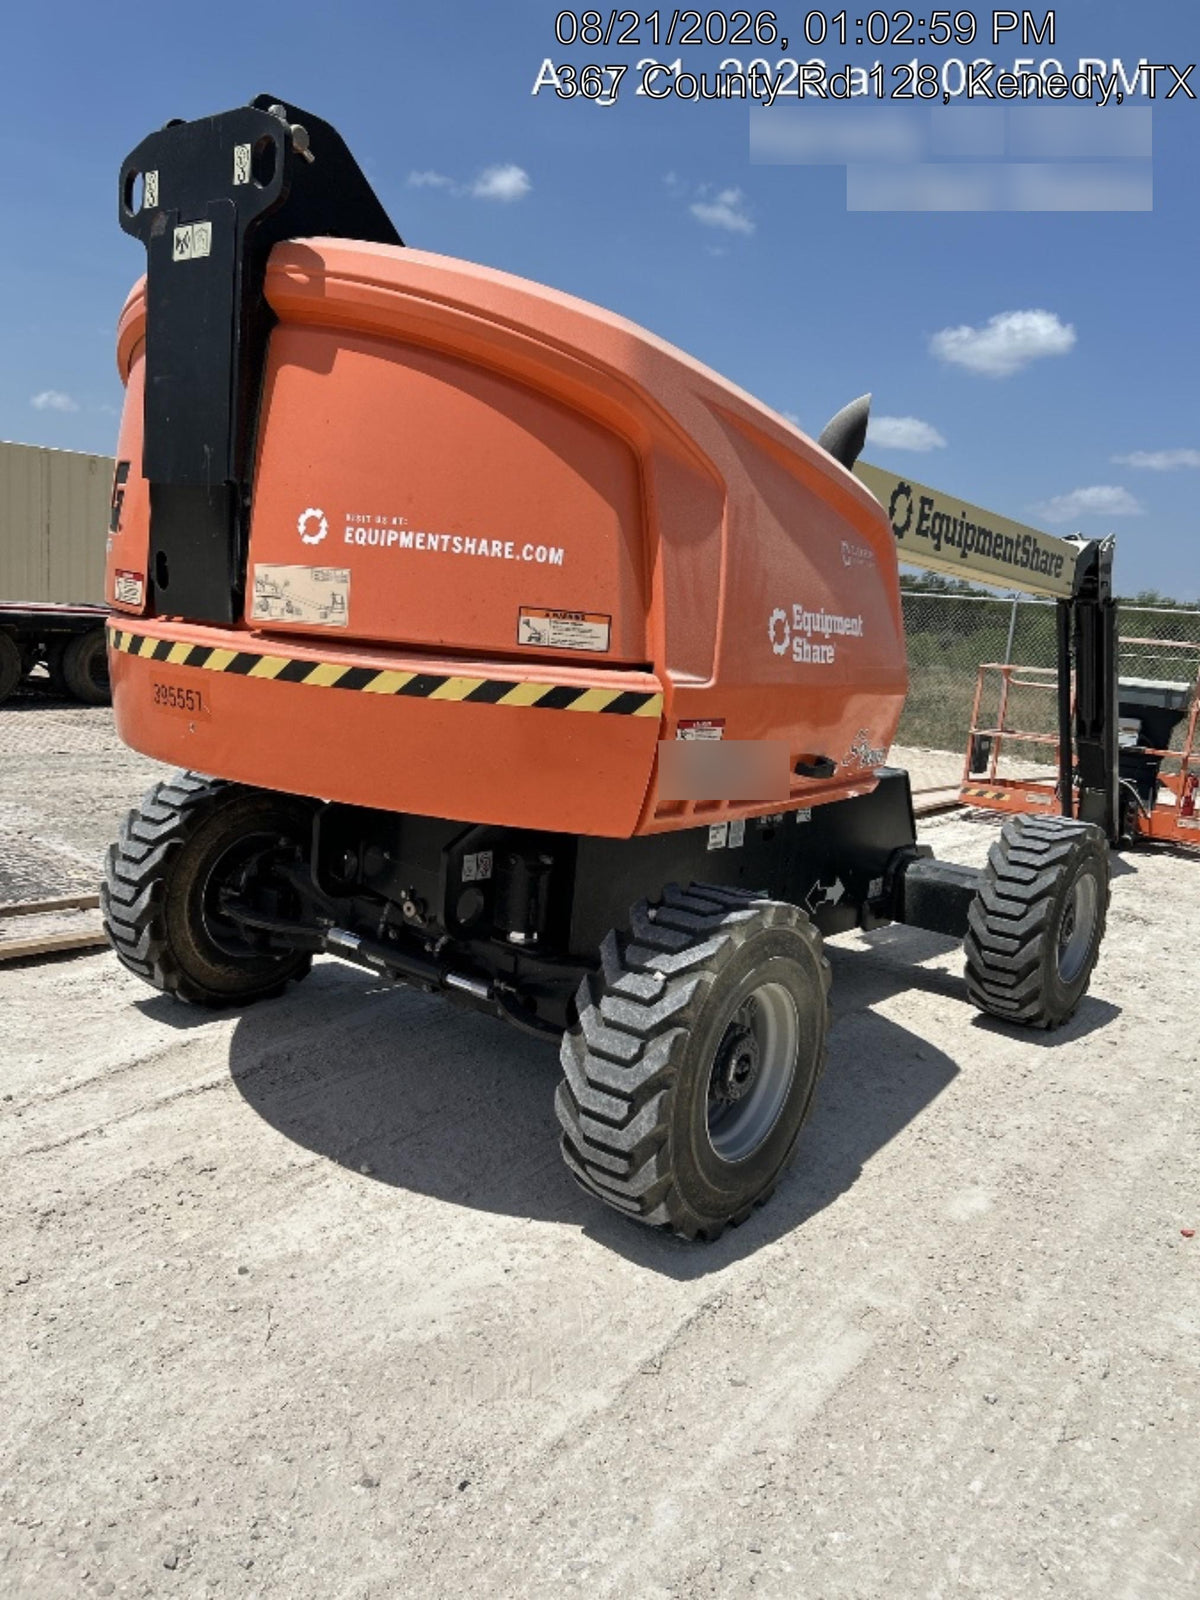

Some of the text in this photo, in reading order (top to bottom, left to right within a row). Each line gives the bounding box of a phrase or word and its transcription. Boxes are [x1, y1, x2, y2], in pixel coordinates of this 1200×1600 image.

[344, 526, 565, 566] EQUIPMENTSHARE.COM
[915, 495, 1064, 579] EquipmentShare
[792, 603, 864, 638] Equipment
[792, 636, 836, 665] Share
